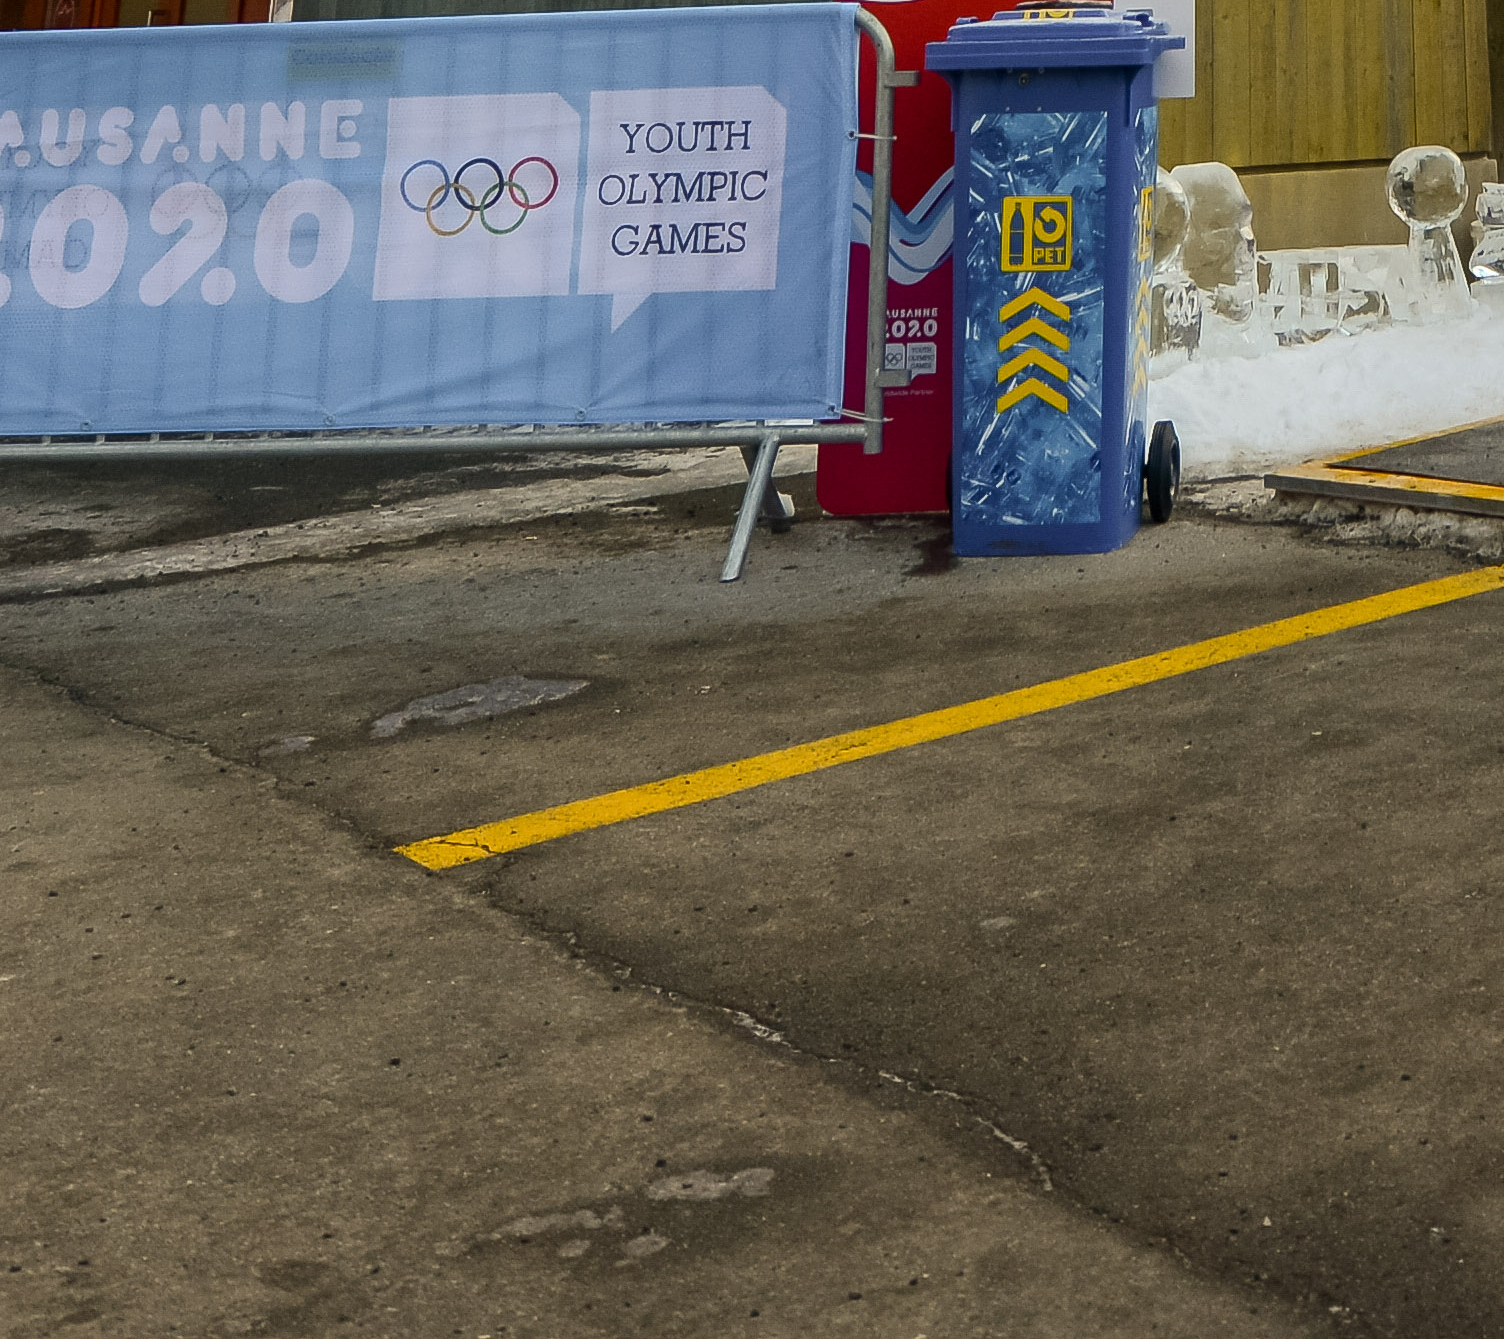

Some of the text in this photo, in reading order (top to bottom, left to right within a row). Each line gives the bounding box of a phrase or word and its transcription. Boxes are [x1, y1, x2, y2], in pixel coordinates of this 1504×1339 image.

[619, 120, 752, 154] YOUTH
[598, 169, 768, 206] OLYMPIC
[611, 221, 747, 256] GAMES
[1033, 247, 1065, 264] PET
[886, 307, 939, 318] AUSANNE
[885, 318, 938, 338] 020
